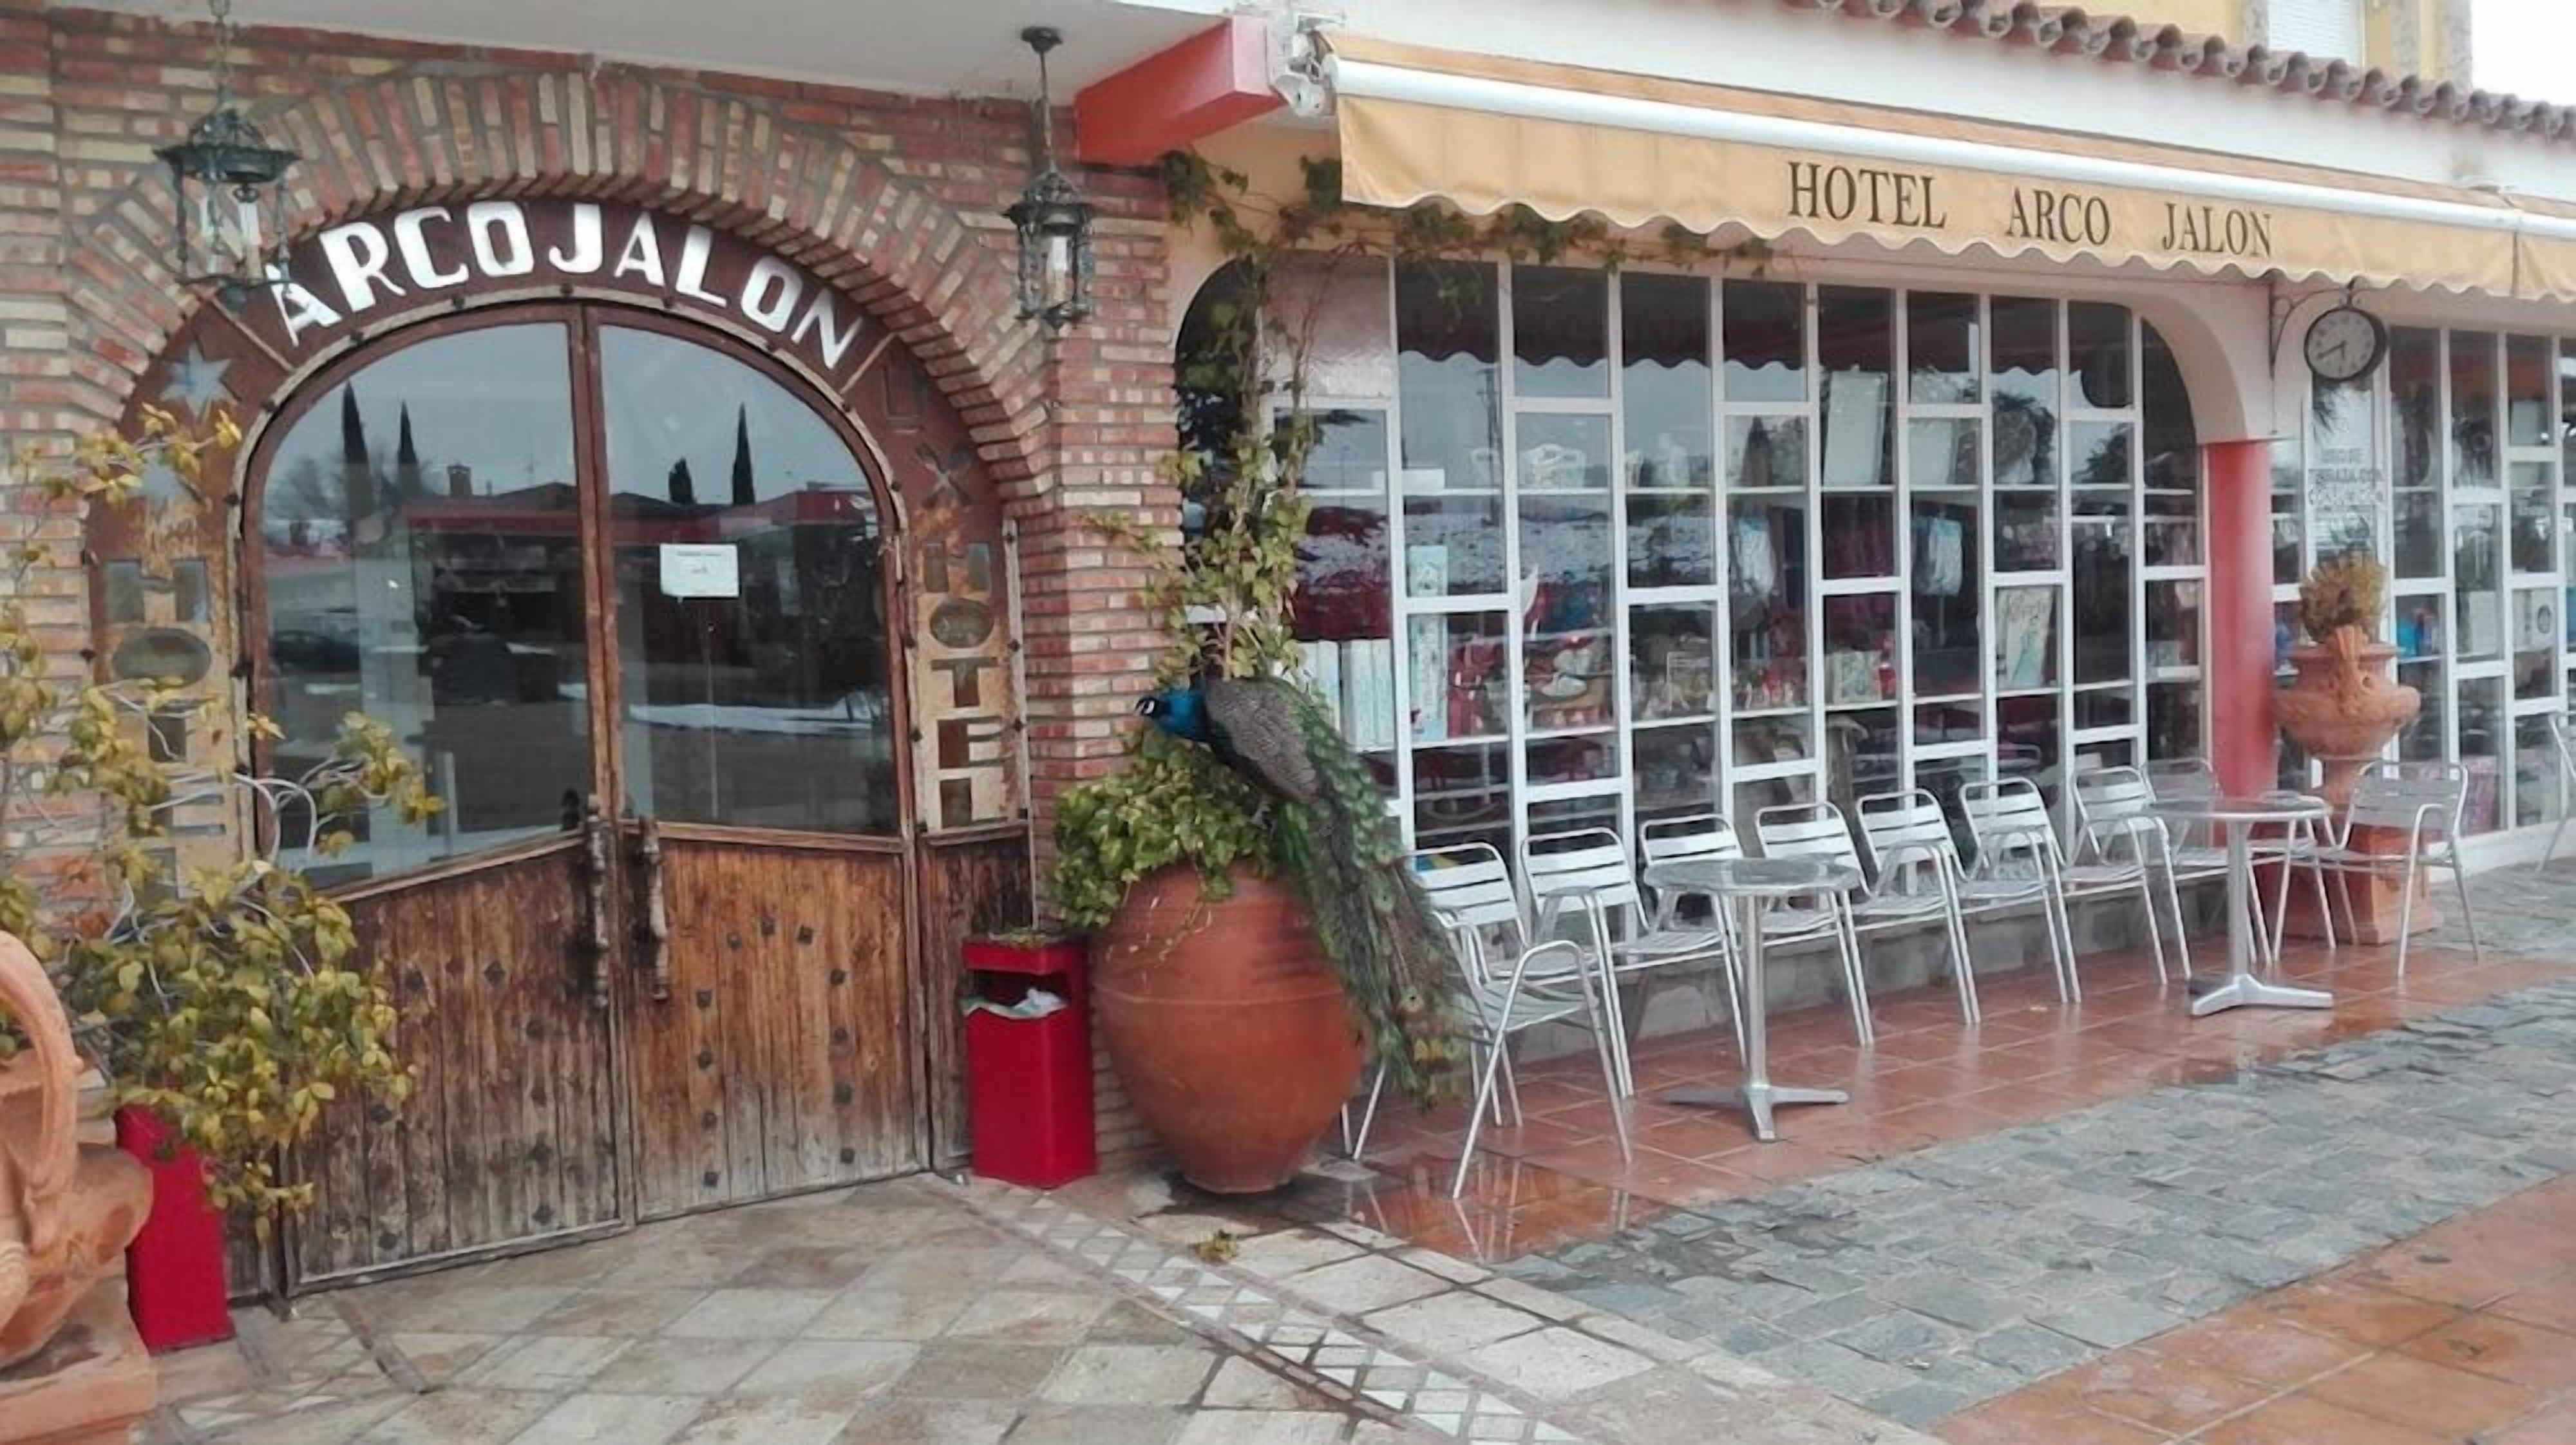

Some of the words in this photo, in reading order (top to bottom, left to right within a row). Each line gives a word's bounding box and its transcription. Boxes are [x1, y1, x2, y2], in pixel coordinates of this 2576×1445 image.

[1788, 162, 1947, 229] HOTEL
[2005, 186, 2110, 245] ARCO
[2162, 203, 2271, 257] JALON
[923, 542, 1009, 829] HOTEL
